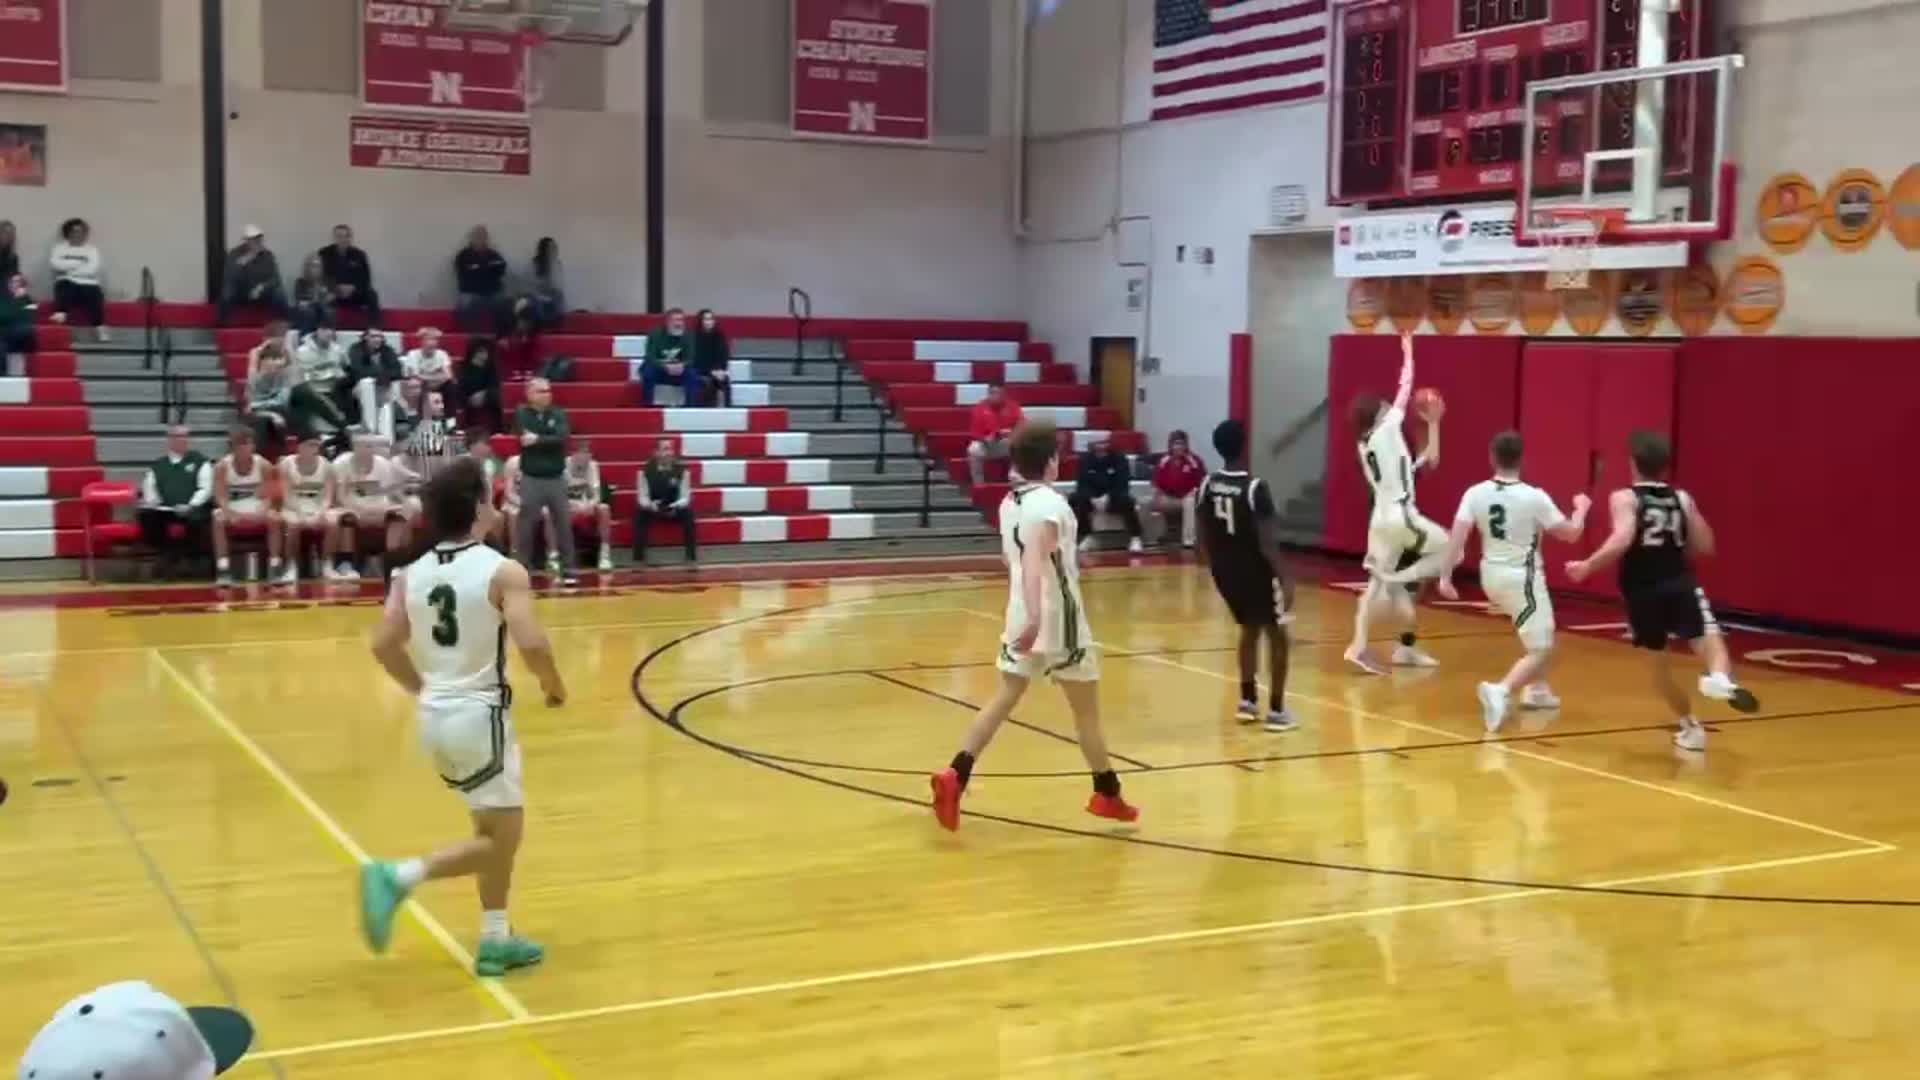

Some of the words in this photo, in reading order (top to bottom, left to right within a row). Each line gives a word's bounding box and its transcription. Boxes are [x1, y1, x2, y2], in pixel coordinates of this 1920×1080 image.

[797, 40, 927, 66] CHAMPIONS
[429, 71, 463, 104] N
[848, 100, 876, 132] N
[1213, 496, 1235, 535] 4
[1488, 504, 1507, 540] 2
[1640, 507, 1685, 548] 24
[428, 583, 460, 647] 3
